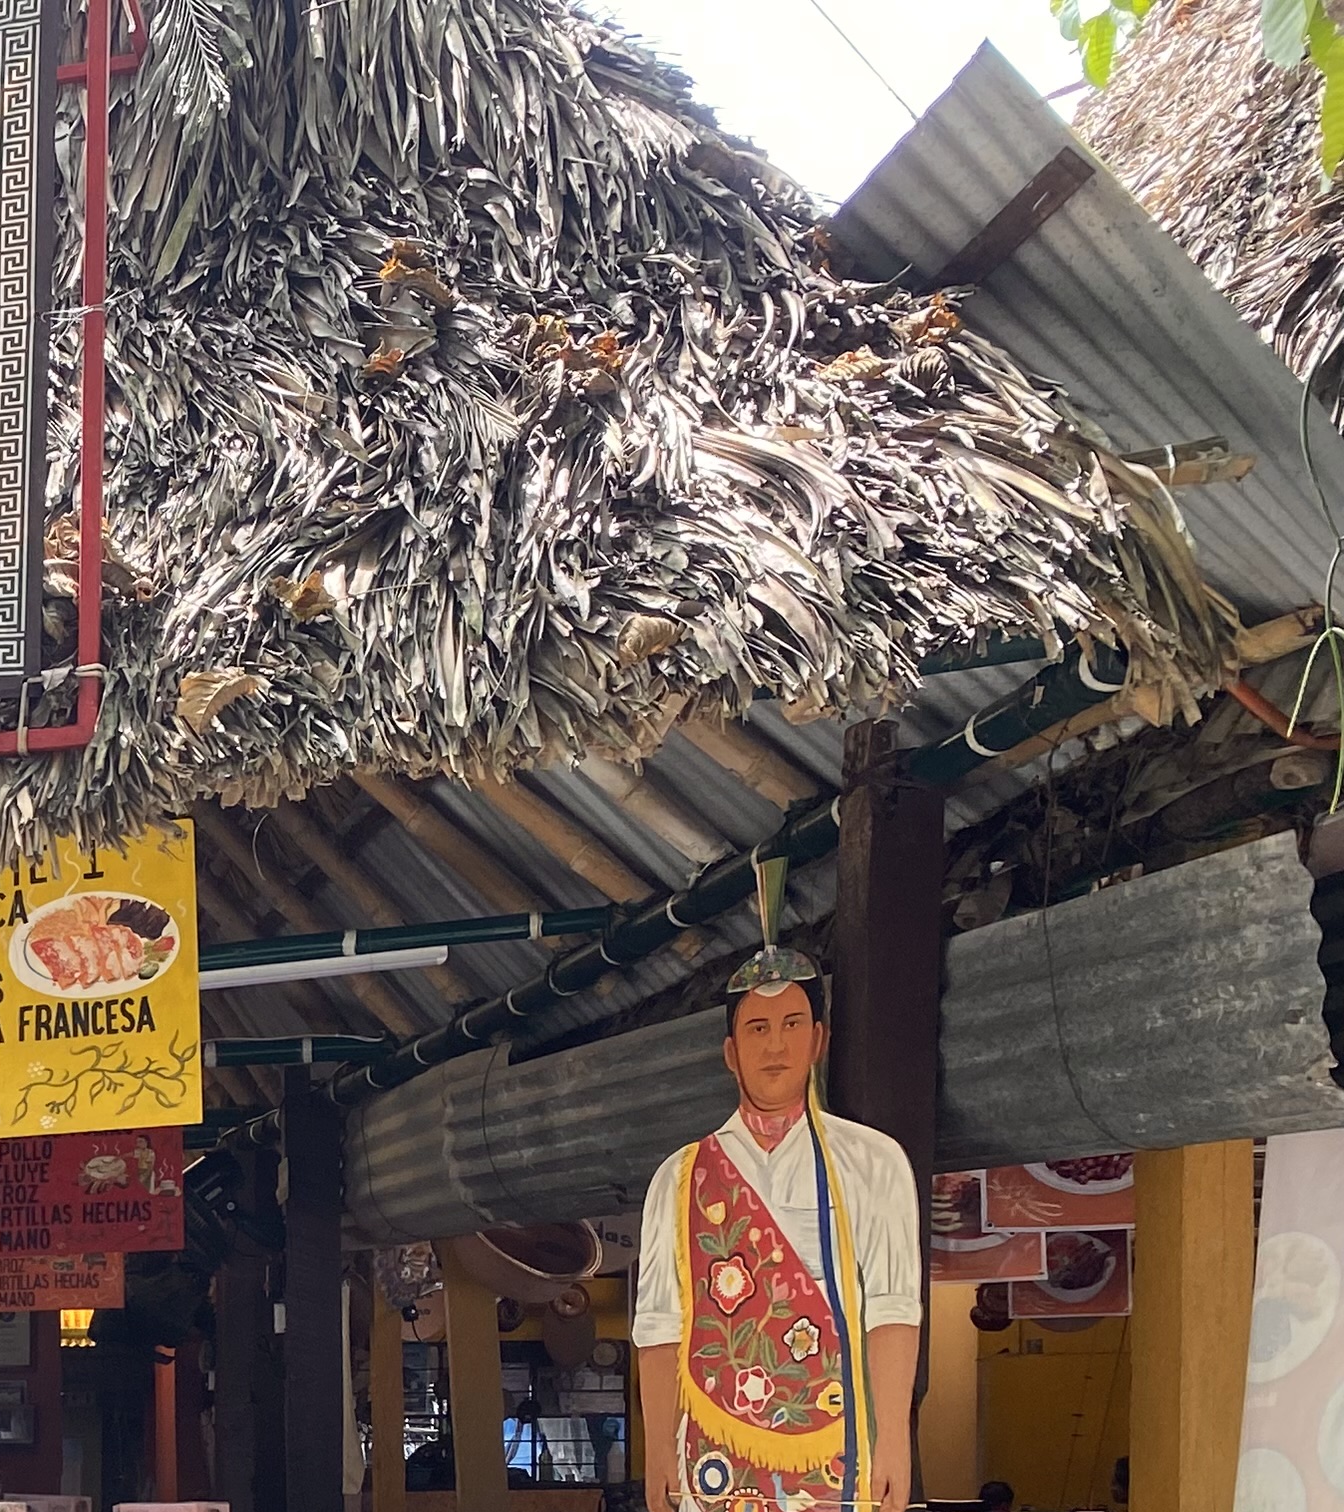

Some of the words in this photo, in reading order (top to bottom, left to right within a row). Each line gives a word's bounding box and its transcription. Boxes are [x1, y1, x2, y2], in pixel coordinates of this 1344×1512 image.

[19, 997, 155, 1041] FRANCESA
[0, 1141, 52, 1161] POLLO
[83, 1202, 151, 1223] HECHAS
[0, 1229, 50, 1250] MANO
[55, 1274, 99, 1288] HECHAS
